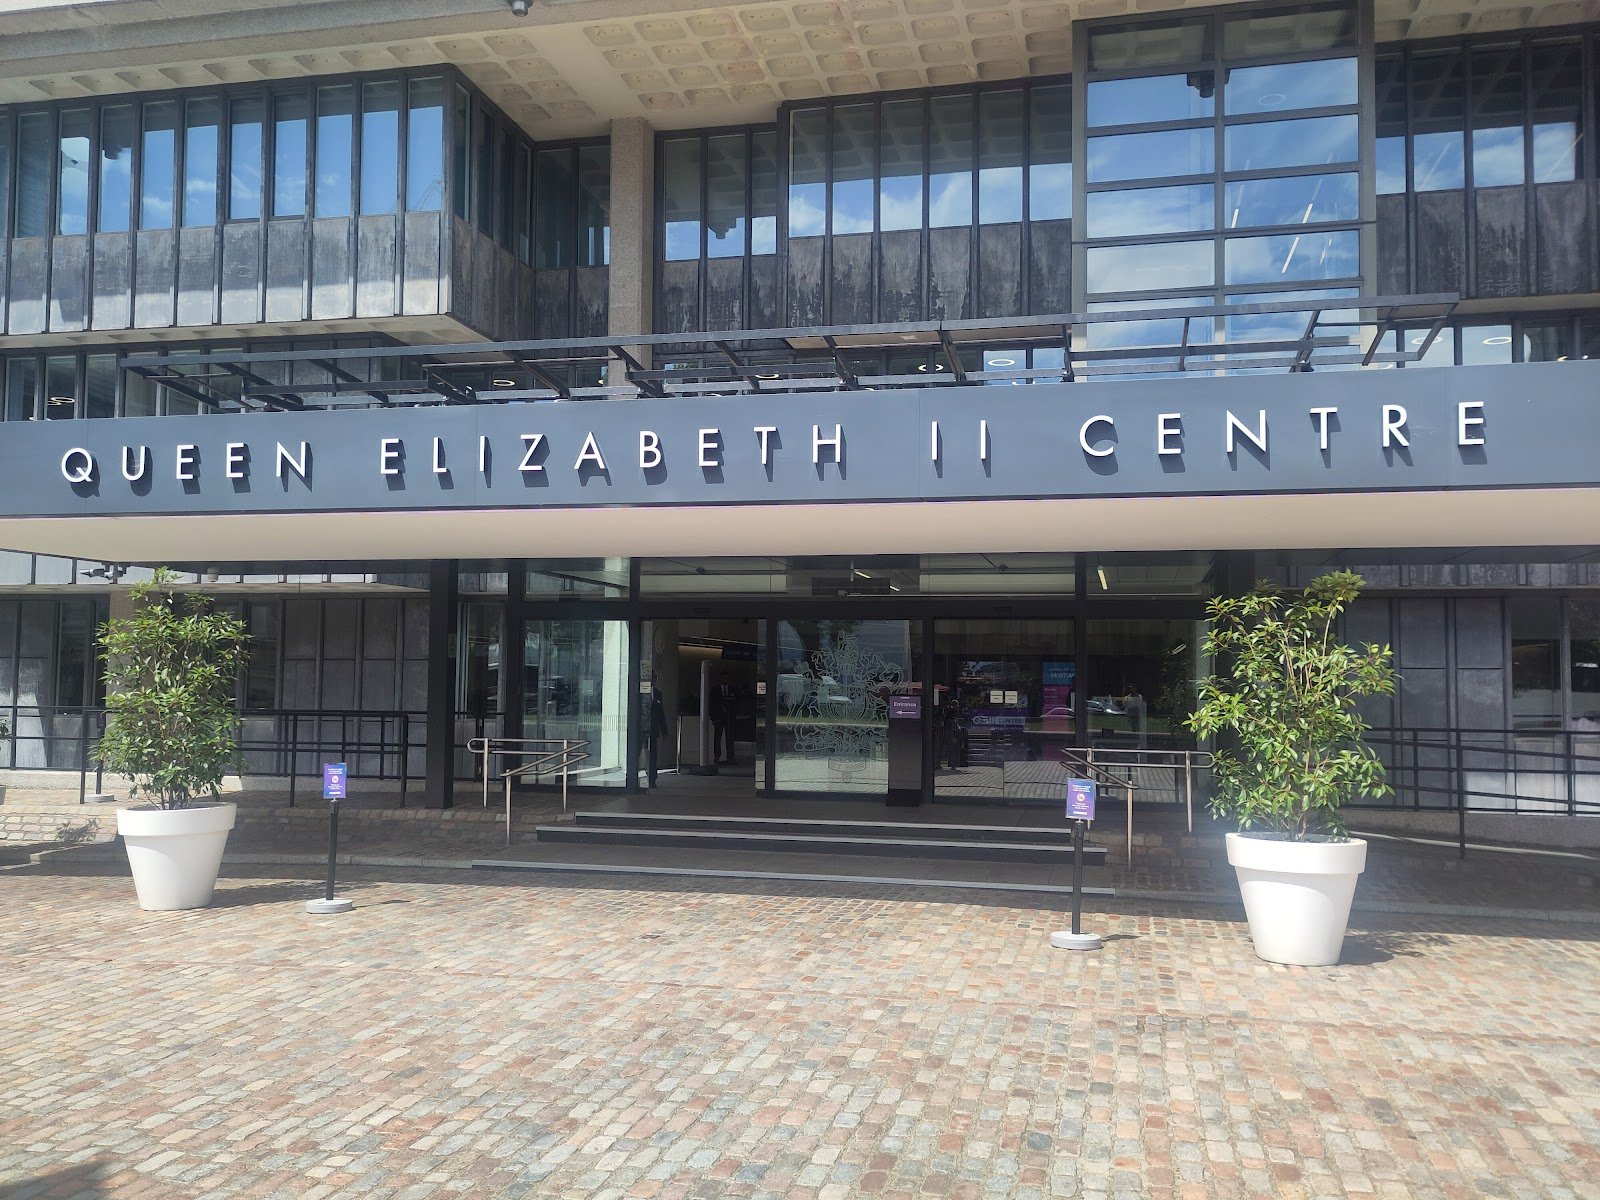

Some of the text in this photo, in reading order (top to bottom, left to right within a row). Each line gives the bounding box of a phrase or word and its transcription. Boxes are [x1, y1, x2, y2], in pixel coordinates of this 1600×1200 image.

[61, 401, 1485, 485] QUEEN ELIZABETH II CENTRE
